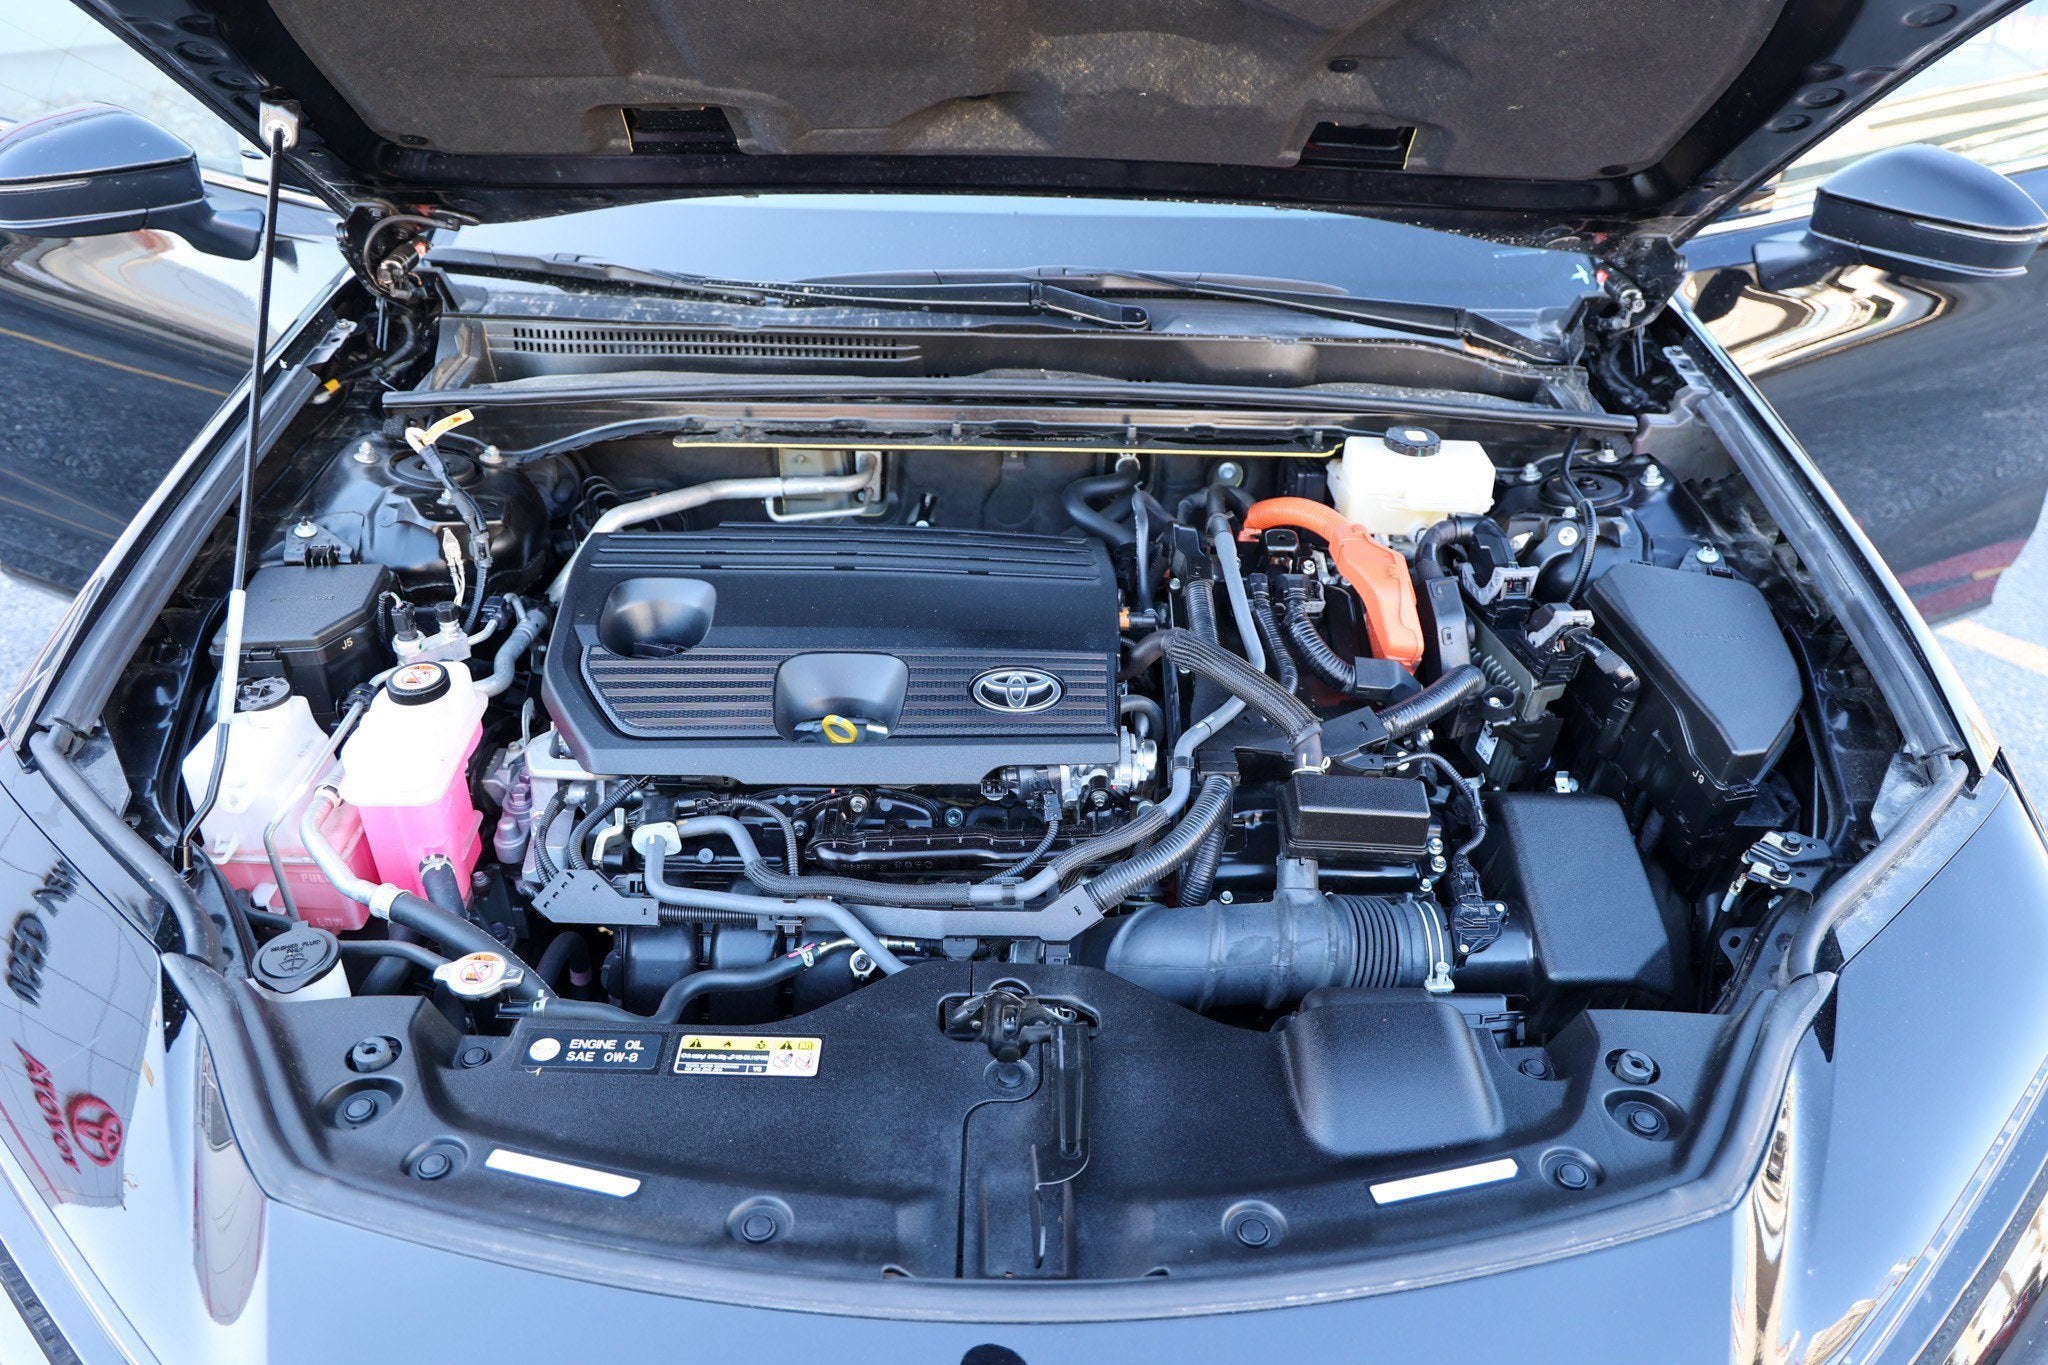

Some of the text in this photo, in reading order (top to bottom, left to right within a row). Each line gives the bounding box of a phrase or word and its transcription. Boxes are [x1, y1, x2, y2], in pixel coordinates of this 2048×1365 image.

[341, 637, 354, 650] J5
[300, 873, 330, 883] FUL
[316, 917, 344, 927] LOW
[569, 1039, 645, 1051] ENGINE OIL
[565, 1051, 639, 1063] SAE 0W-8
